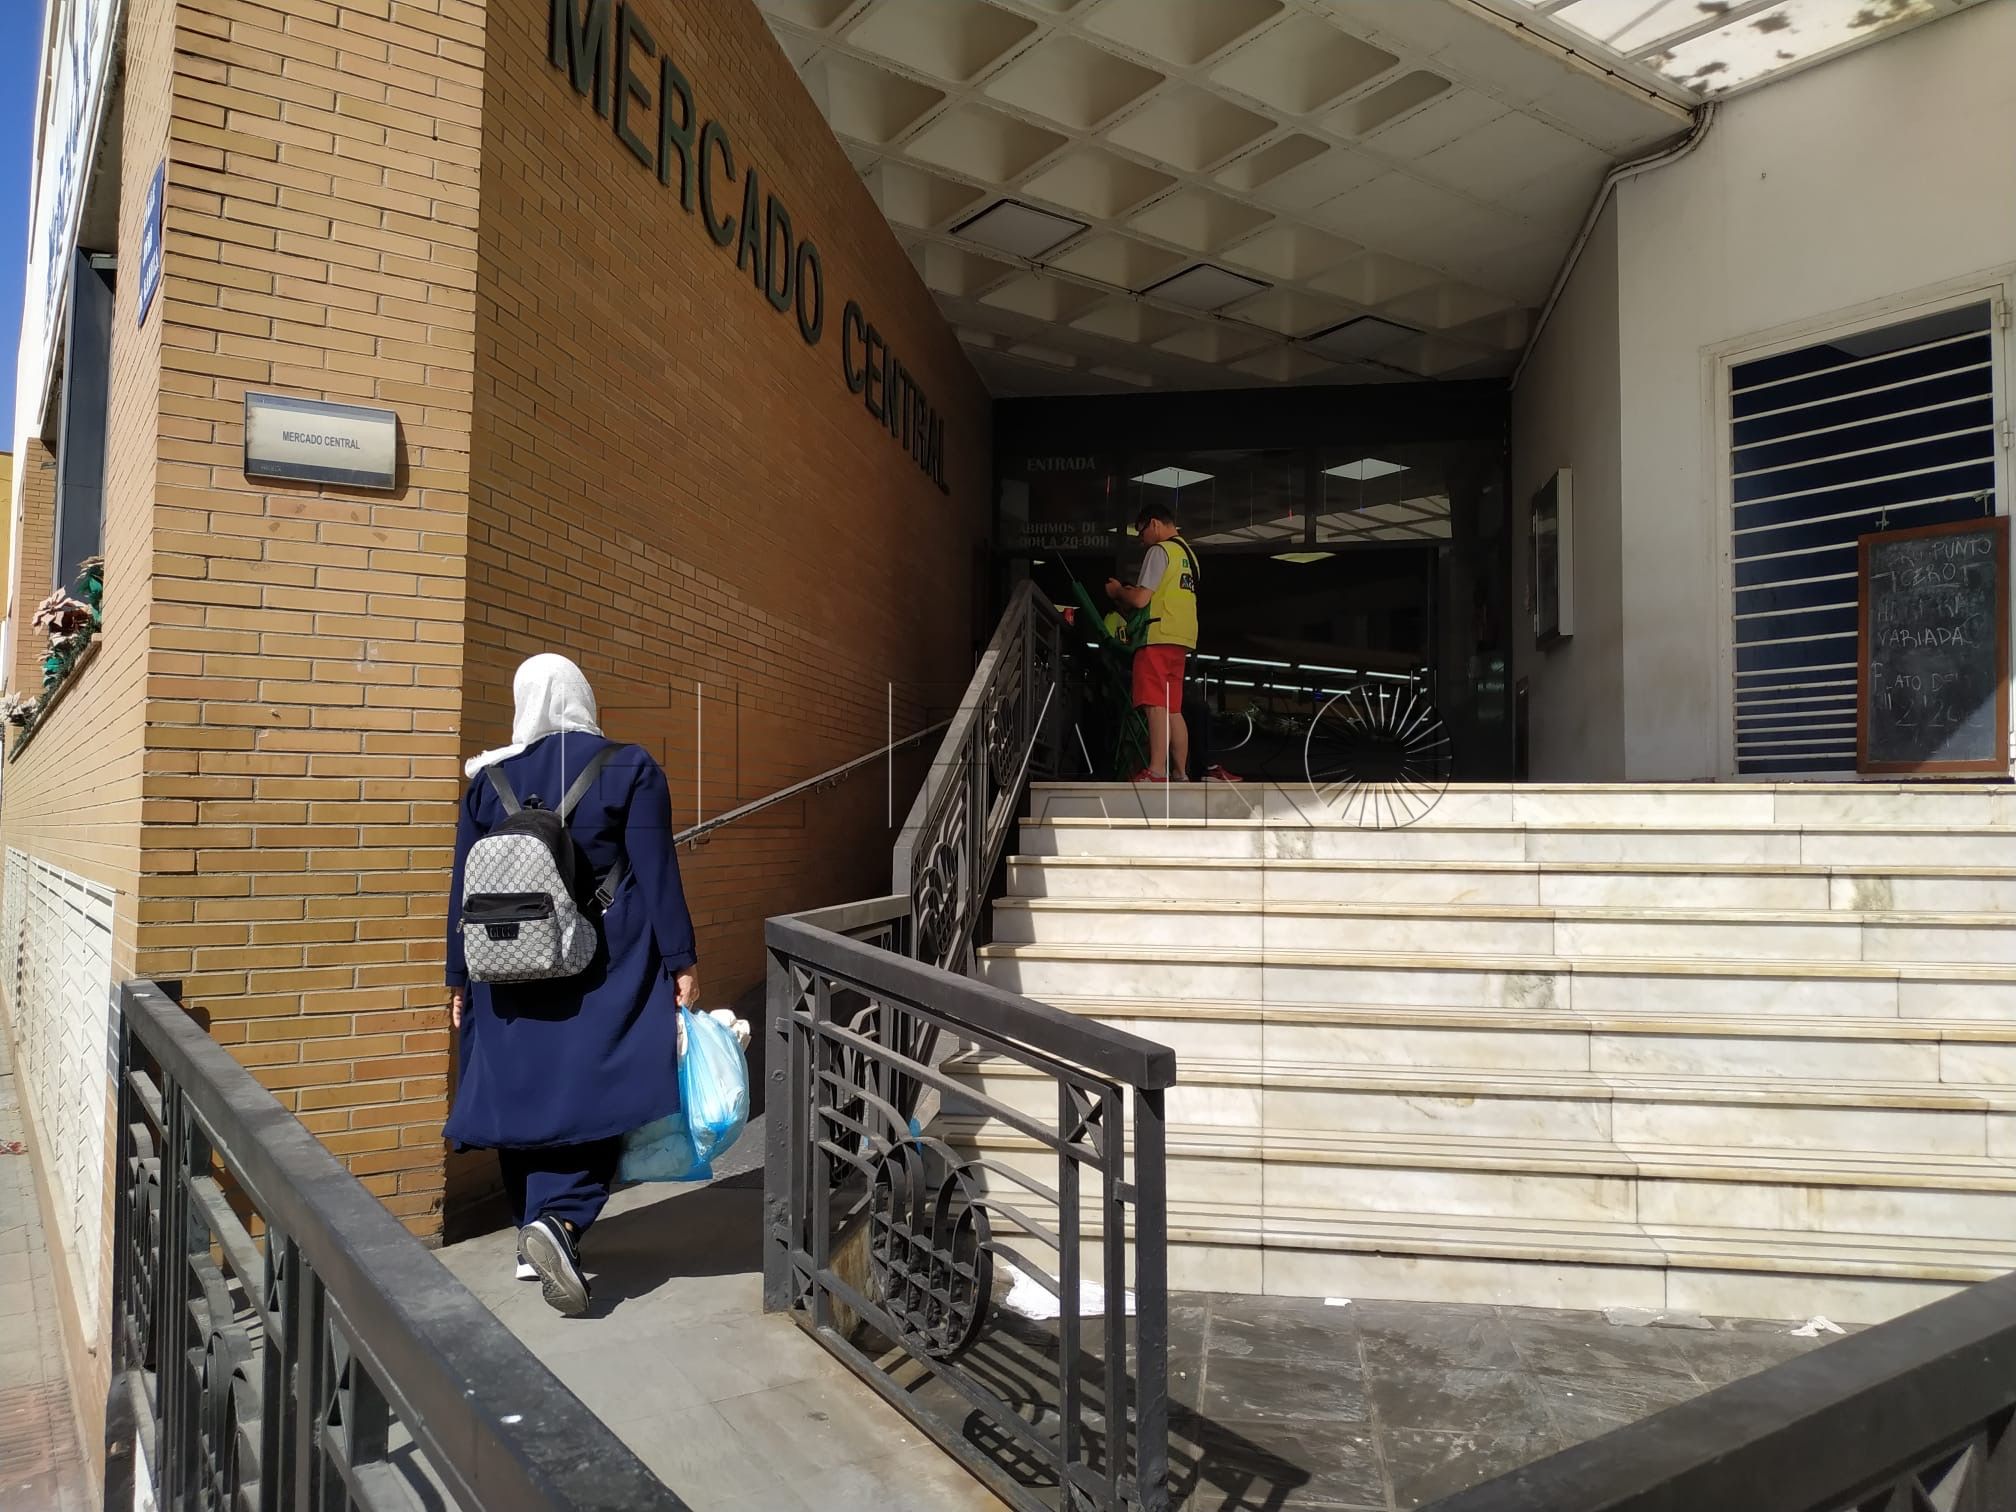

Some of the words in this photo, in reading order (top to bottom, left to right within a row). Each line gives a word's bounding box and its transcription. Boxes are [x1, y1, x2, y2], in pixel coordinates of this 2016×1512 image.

[549, 0, 825, 347] MERCADO
[842, 300, 951, 496] CENTRAL
[282, 431, 322, 446] MERCADO
[324, 436, 361, 450] CENTRAL
[1026, 455, 1097, 471] ENTRADA
[1932, 537, 1992, 560] PUNTO
[1878, 625, 1970, 648] VARIADA
